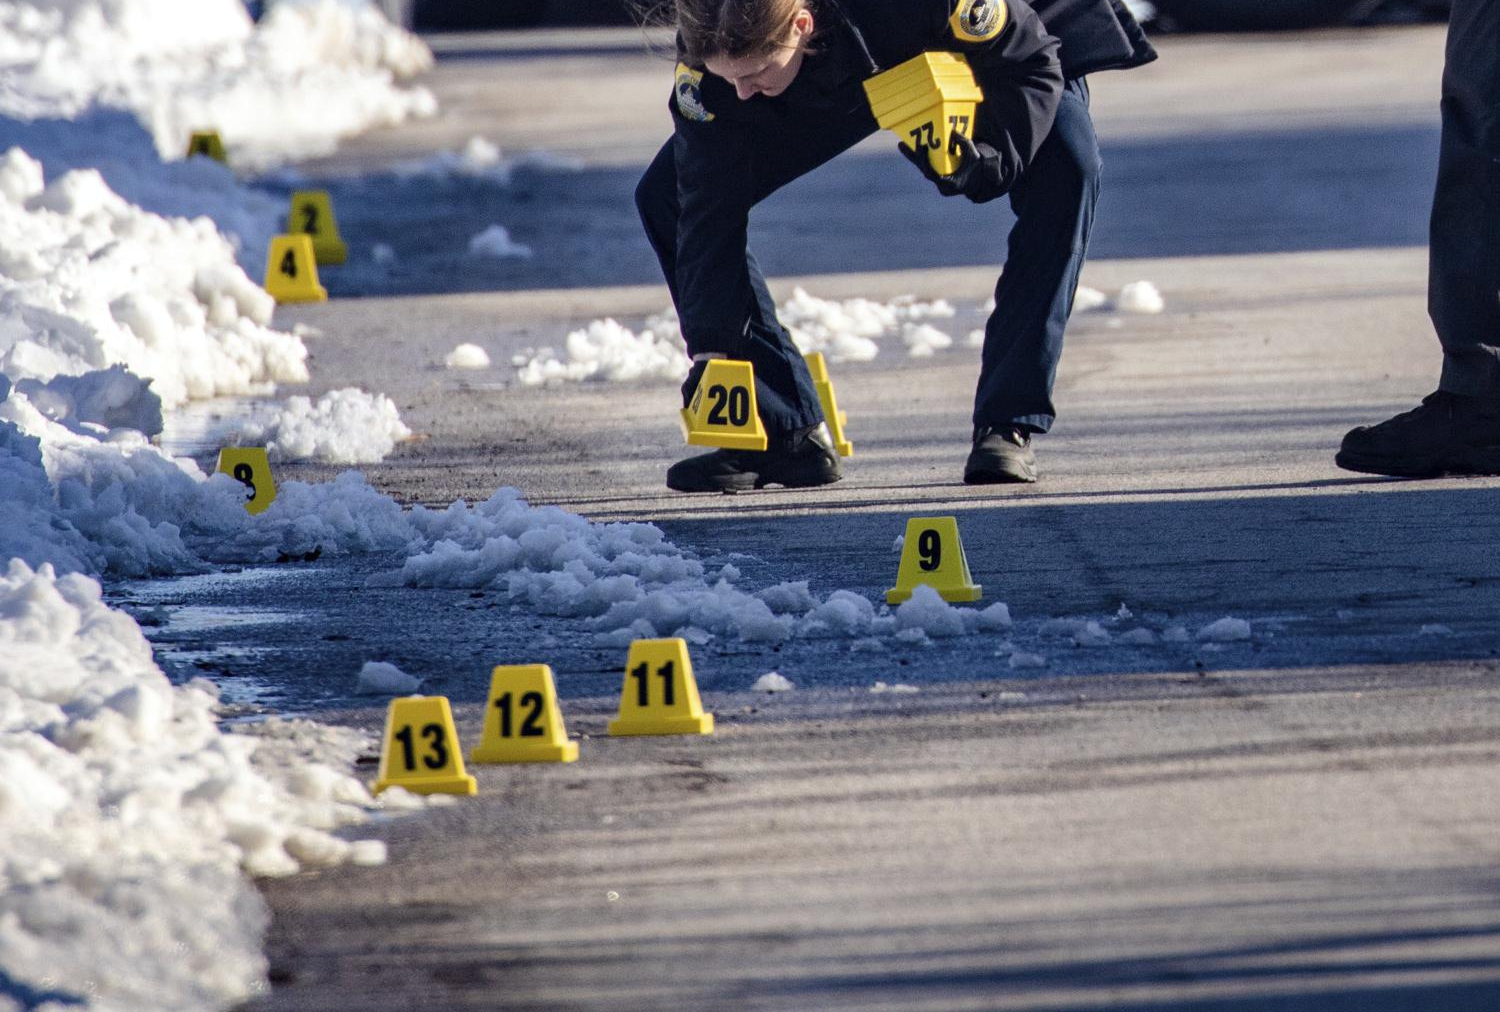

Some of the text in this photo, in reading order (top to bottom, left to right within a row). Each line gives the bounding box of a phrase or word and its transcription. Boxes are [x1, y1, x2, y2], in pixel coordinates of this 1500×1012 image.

[302, 203, 319, 234] 2
[280, 249, 298, 279] 4
[707, 384, 750, 427] 20
[918, 529, 942, 571] 9
[631, 660, 675, 708] 11
[494, 691, 545, 739] 12
[394, 722, 449, 772] 13
